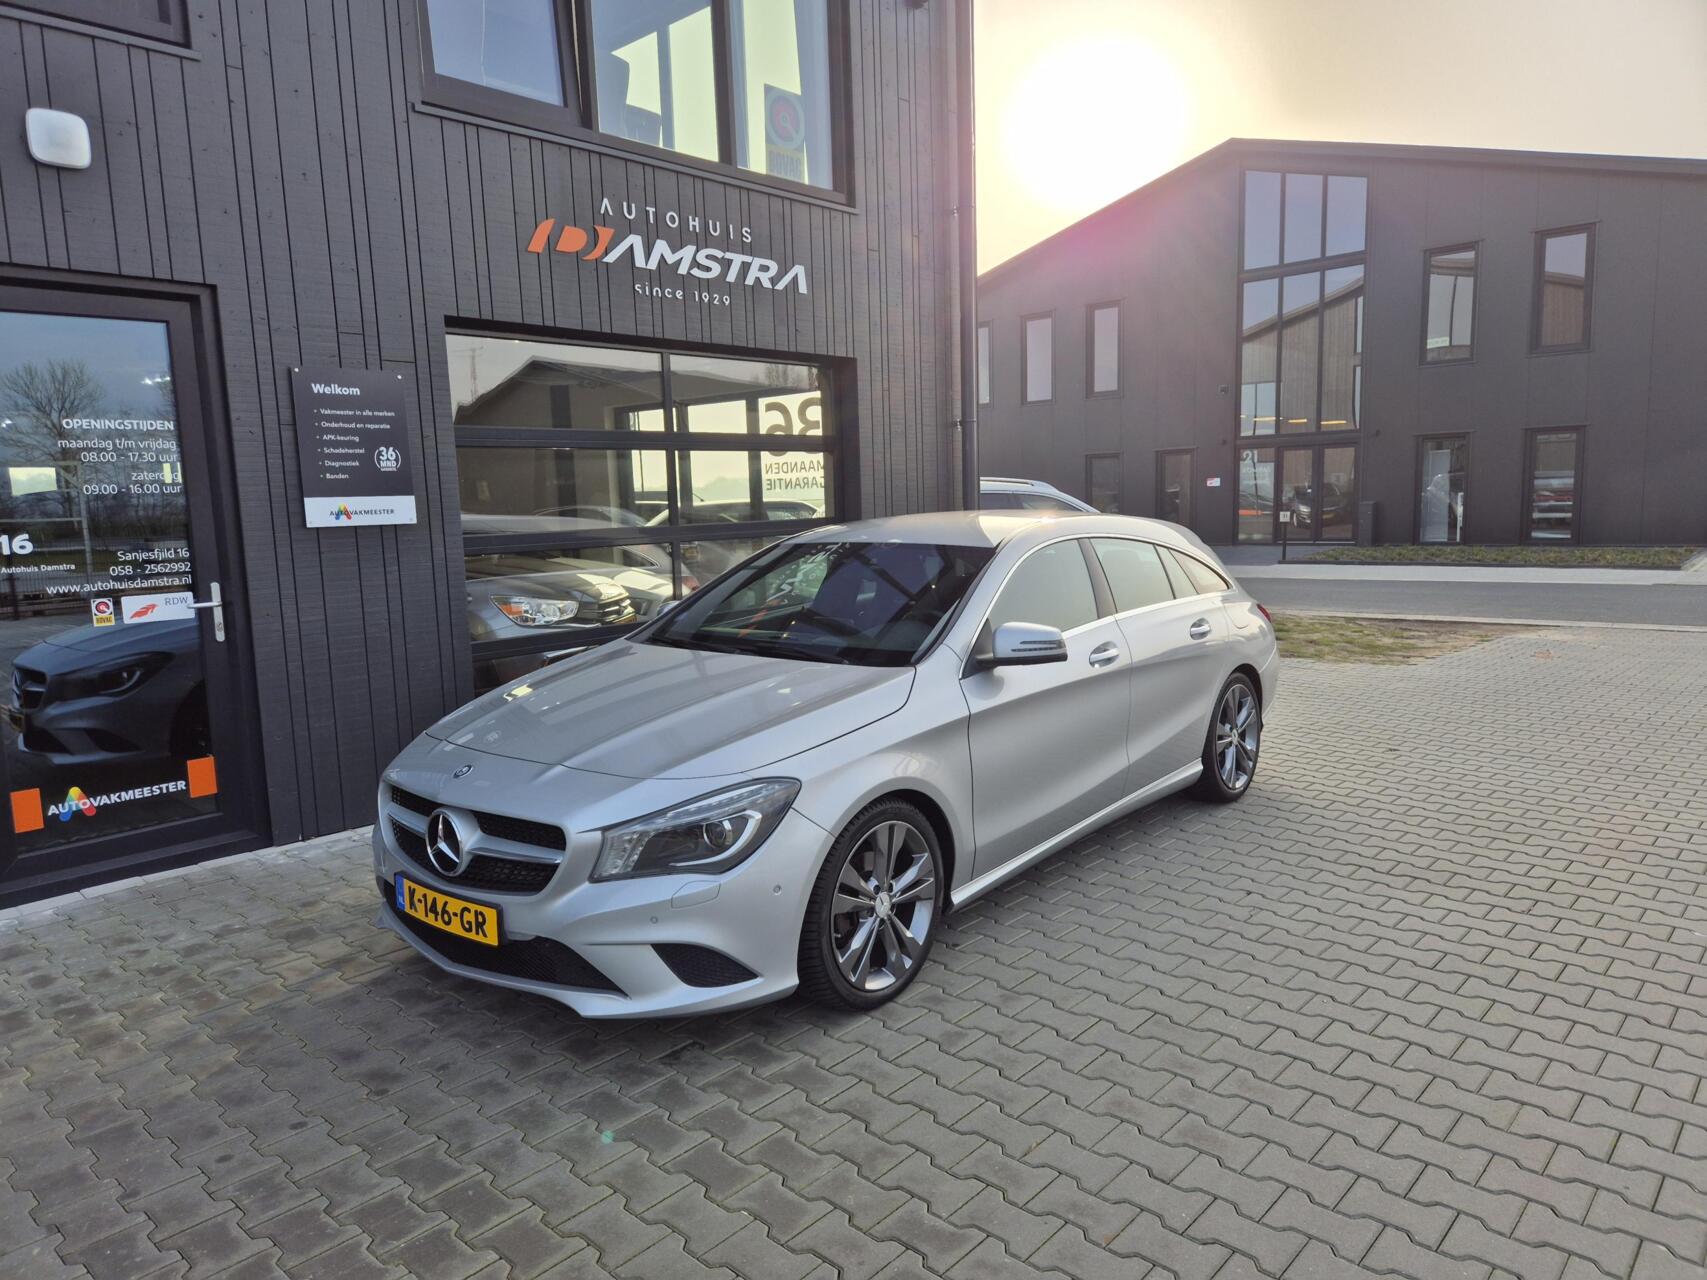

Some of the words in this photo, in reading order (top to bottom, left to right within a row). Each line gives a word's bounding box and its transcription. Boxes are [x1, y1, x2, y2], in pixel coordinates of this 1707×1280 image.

[600, 197, 752, 243] AUTOHUIS
[527, 218, 808, 294] DAMSTRA
[634, 283, 683, 299] since
[694, 291, 730, 306] 1929
[311, 383, 360, 395] Welkom
[62, 418, 174, 431] OPENINGSTIJDEN
[58, 439, 112, 450] maandag
[116, 439, 135, 449] t/m
[138, 438, 177, 451] vrijdag
[81, 452, 117, 462] 08.00
[129, 452, 156, 462] 17.30
[159, 454, 178, 462] uur
[379, 447, 396, 460] 36
[1242, 450, 1258, 463] 21
[131, 468, 182, 483] zaterdg
[83, 485, 118, 495] 09.00
[129, 484, 160, 494] 16.00
[163, 485, 182, 494] uur
[0, 533, 34, 555] 16
[117, 548, 175, 561] Sanjesfjild
[177, 548, 190, 558] 16
[1, 565, 39, 574] Autohuis
[41, 564, 76, 572] Damstra
[110, 565, 133, 576] 058
[145, 562, 191, 574] 2562992
[46, 575, 192, 594] www.autohuisdamstra.nl
[164, 597, 188, 606] RDW
[48, 780, 186, 816] AUTOVAKMEESTER
[408, 886, 488, 938] K-146-GR
